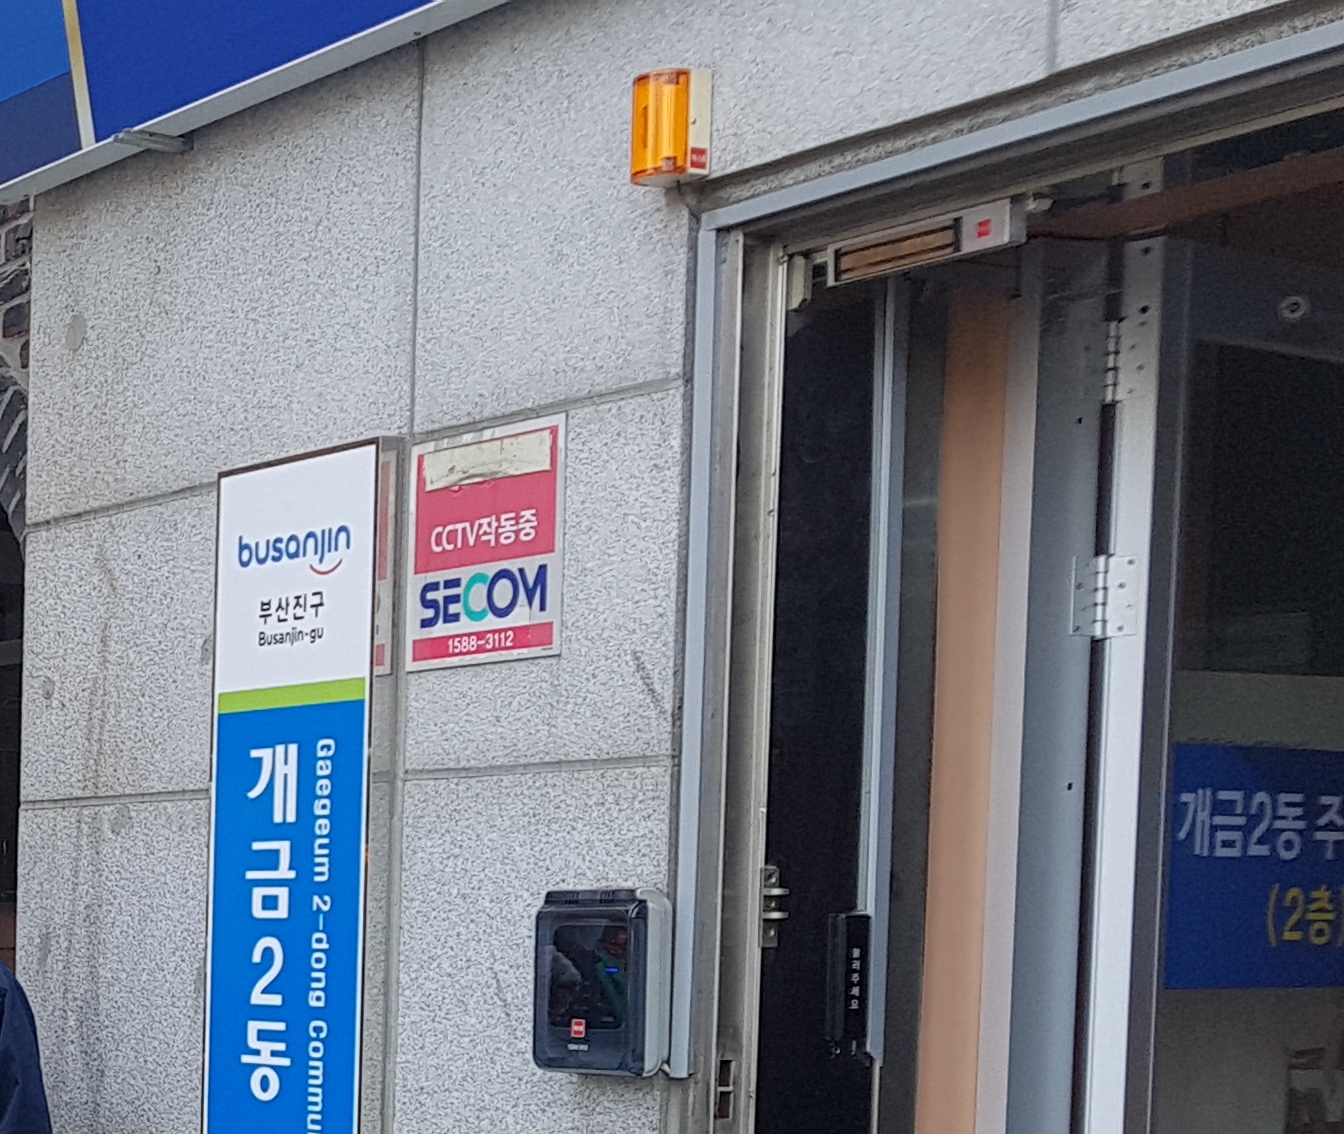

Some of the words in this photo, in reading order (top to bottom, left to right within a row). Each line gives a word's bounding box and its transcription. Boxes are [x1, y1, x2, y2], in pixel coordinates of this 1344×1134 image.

[238, 524, 351, 568] busanjin
[431, 508, 538, 553] CCTV작동중
[259, 590, 325, 625] 부산진구
[420, 563, 548, 629] SECOM
[258, 625, 324, 647] Busanjin-gu
[447, 630, 514, 654] 1588-3112
[313, 738, 335, 882] Gaegeum
[1177, 787, 1307, 861] 개금2동
[241, 743, 298, 1102] 개금2동
[308, 895, 331, 1007] 2-dong
